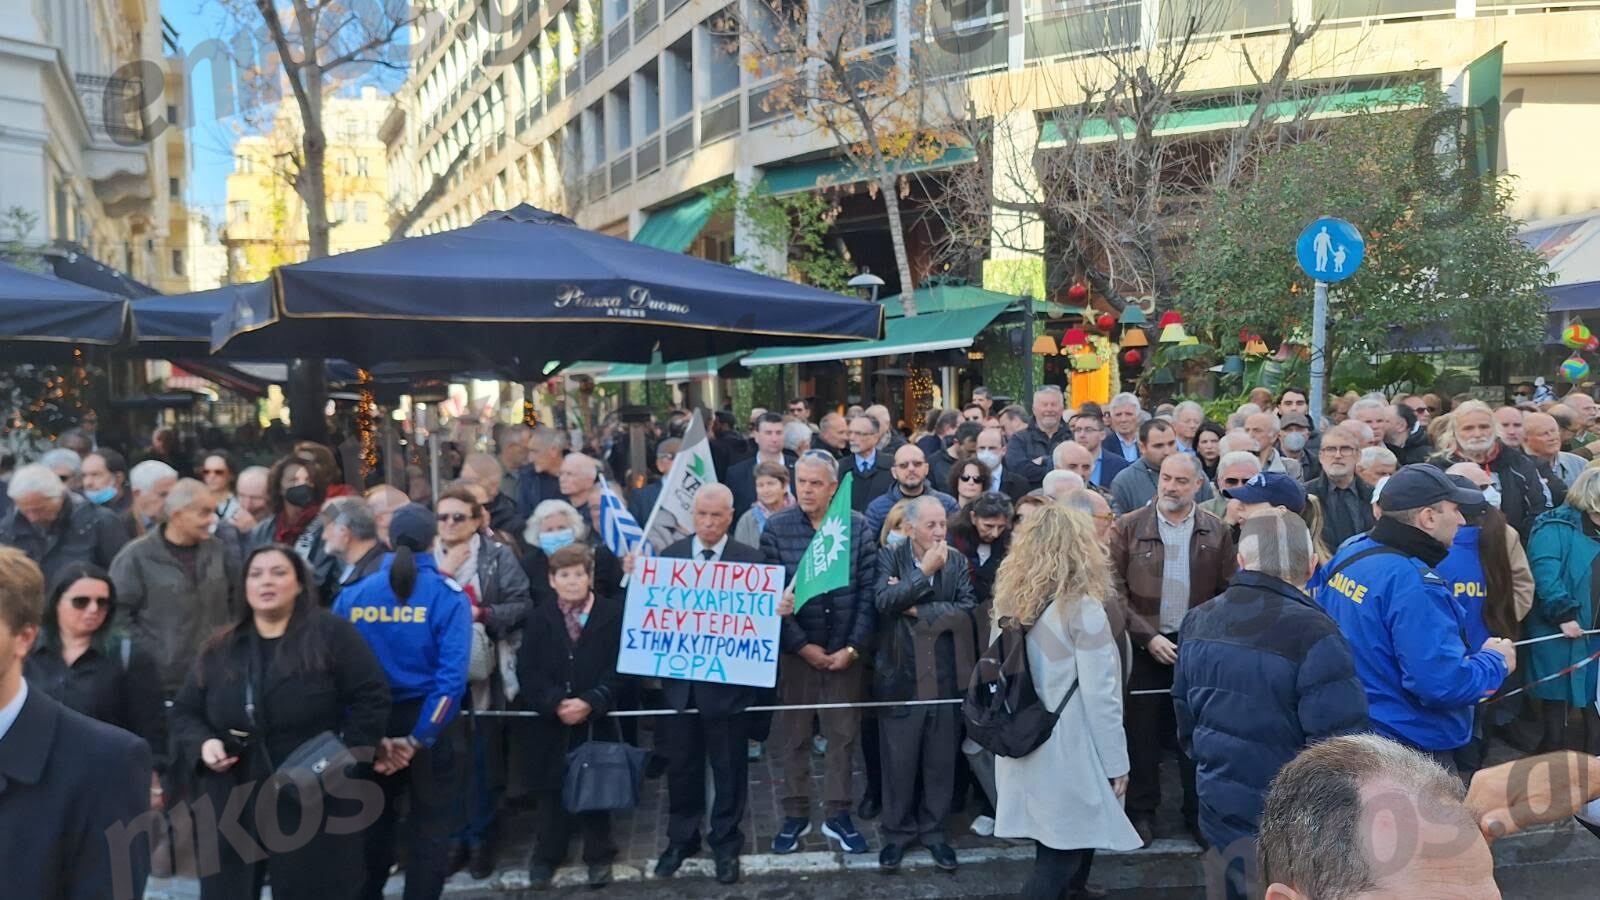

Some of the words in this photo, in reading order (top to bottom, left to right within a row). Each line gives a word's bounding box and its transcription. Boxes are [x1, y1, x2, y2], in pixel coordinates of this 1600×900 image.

[554, 284, 622, 308] Piazza
[628, 285, 690, 314] Duomo
[607, 308, 646, 318] ATHENS
[641, 559, 657, 585] Η
[670, 559, 778, 593] ΚΥΠΡΟΣ
[350, 605, 427, 623] POLICE
[642, 608, 758, 636] ΛΕΥΤΕΡΙΑ
[626, 628, 675, 653] ΣΤΗΝ
[653, 652, 727, 682] ΤΩΡΑ
